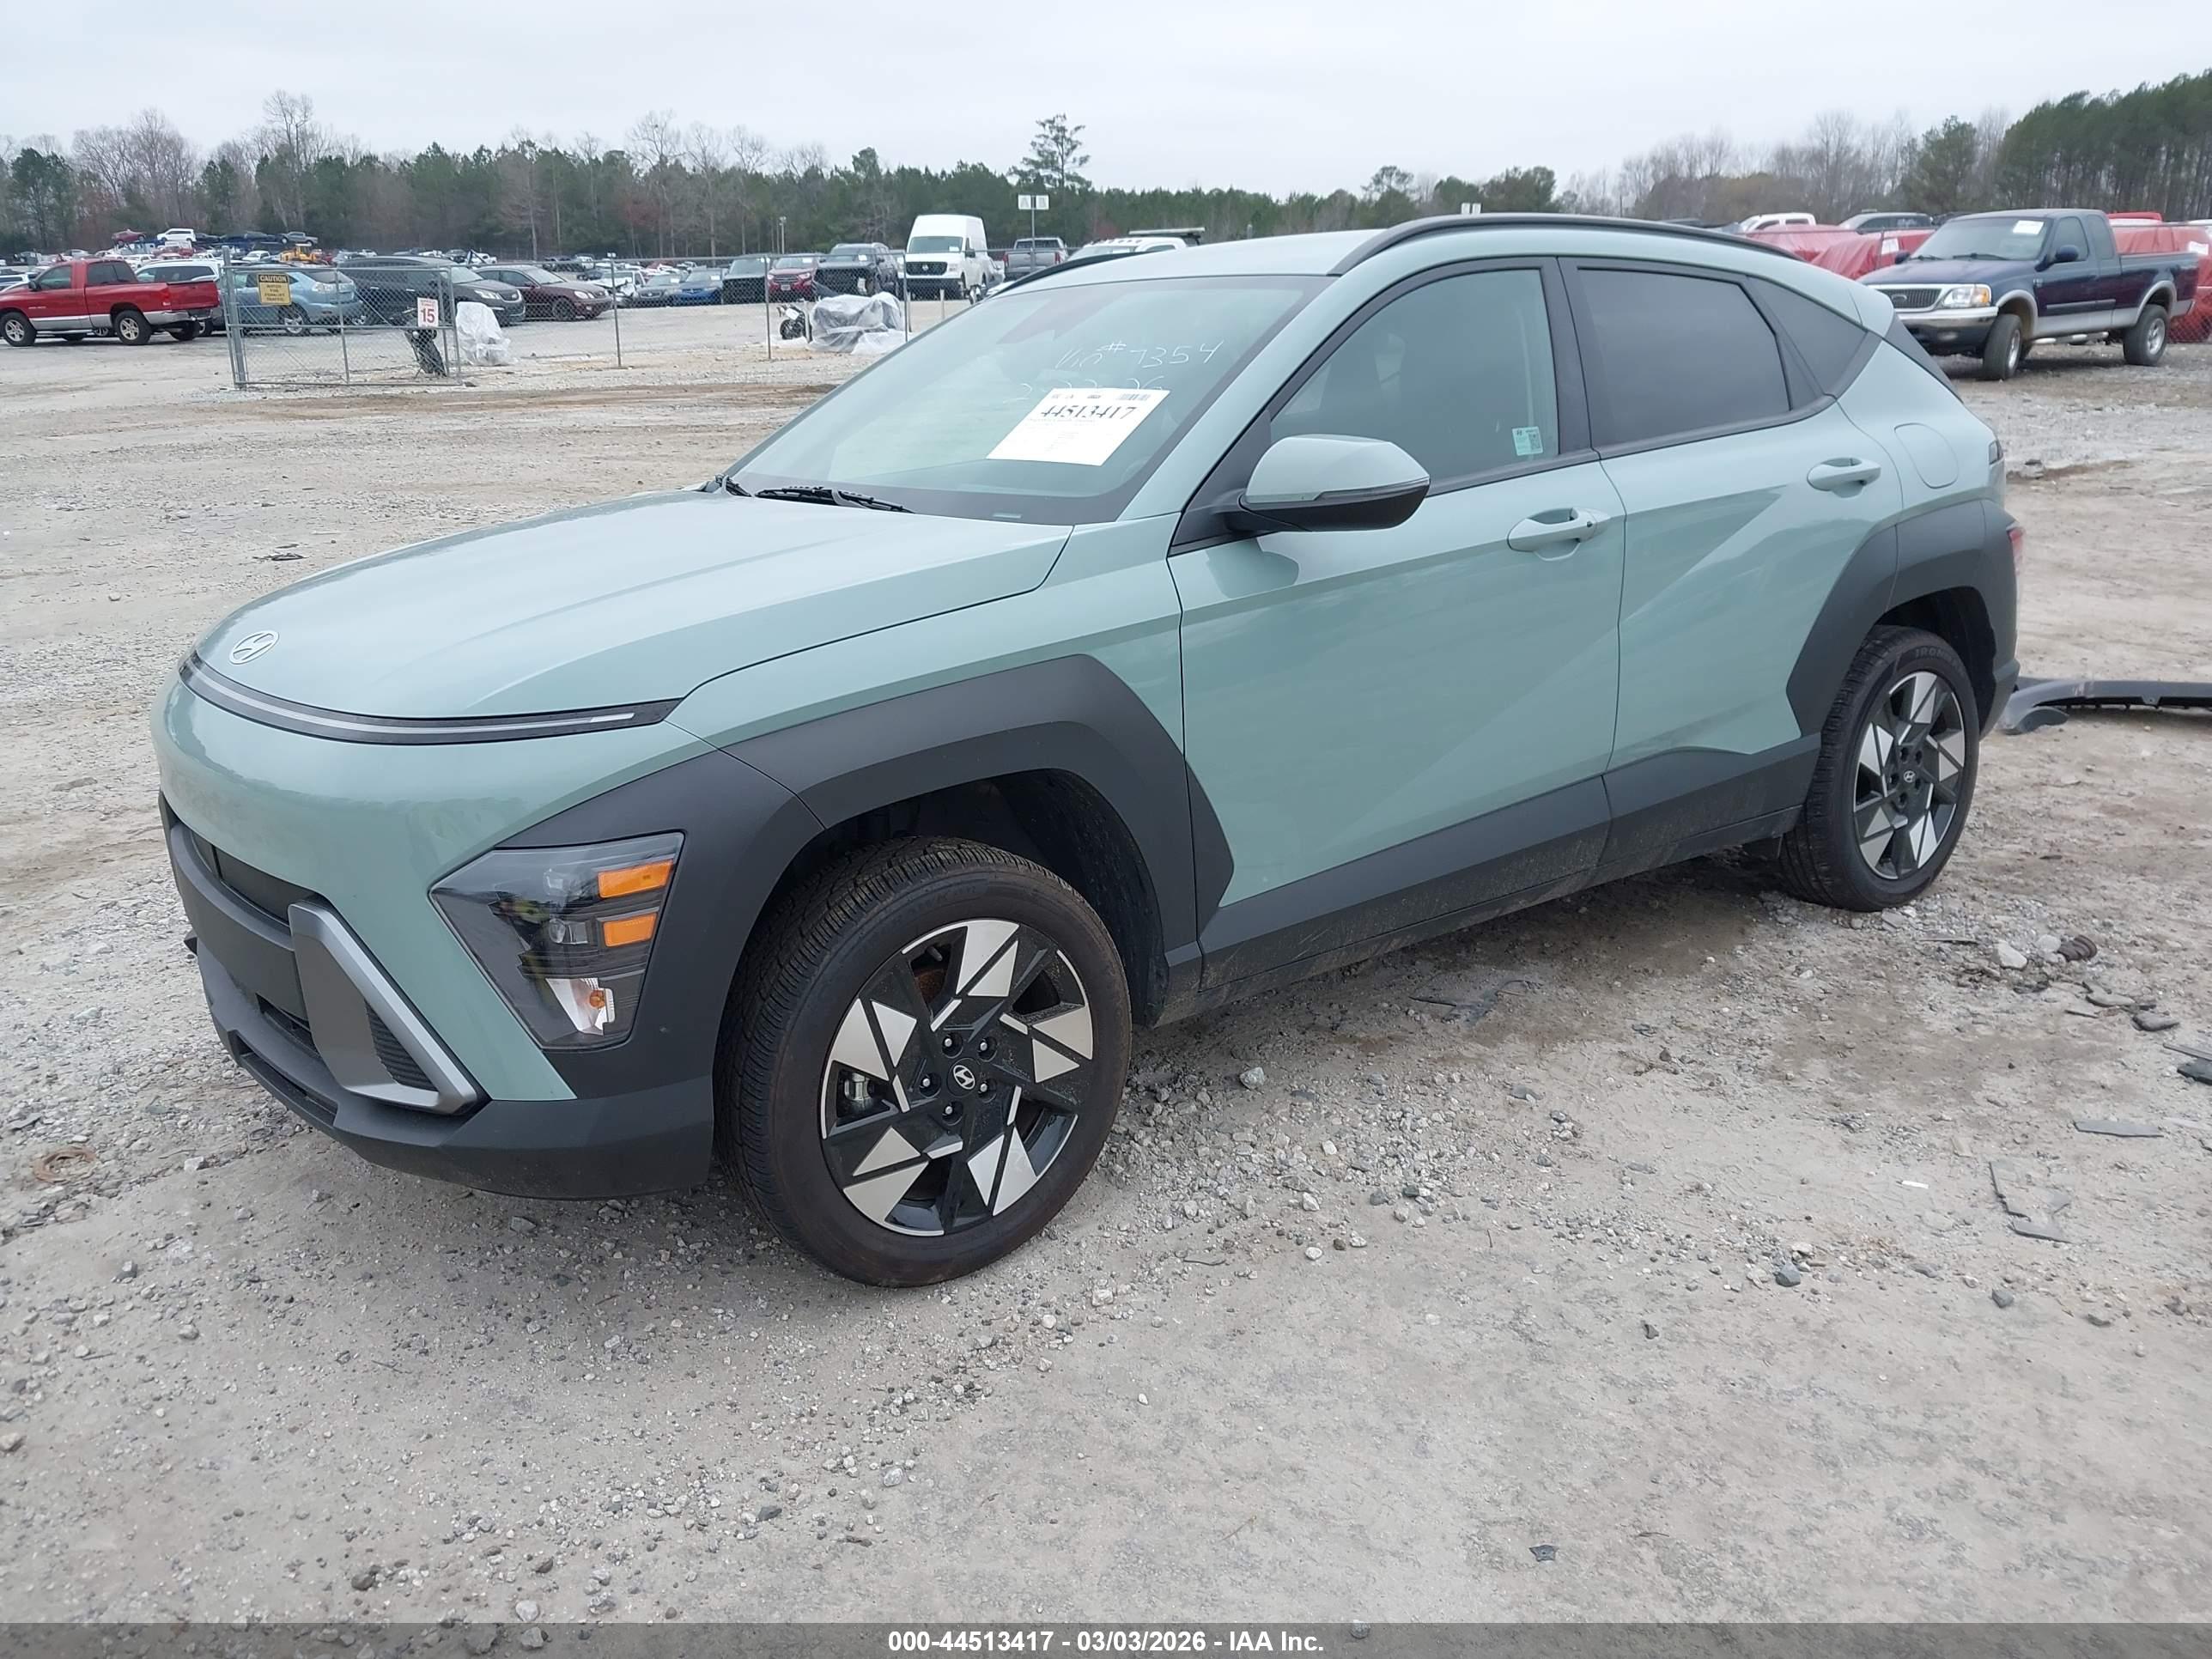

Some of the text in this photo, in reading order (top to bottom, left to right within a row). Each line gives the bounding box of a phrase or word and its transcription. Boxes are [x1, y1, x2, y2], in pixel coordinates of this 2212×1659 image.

[421, 308, 435, 324] 15
[1130, 340, 1224, 368] 7354
[1041, 404, 1137, 419] 44513417
